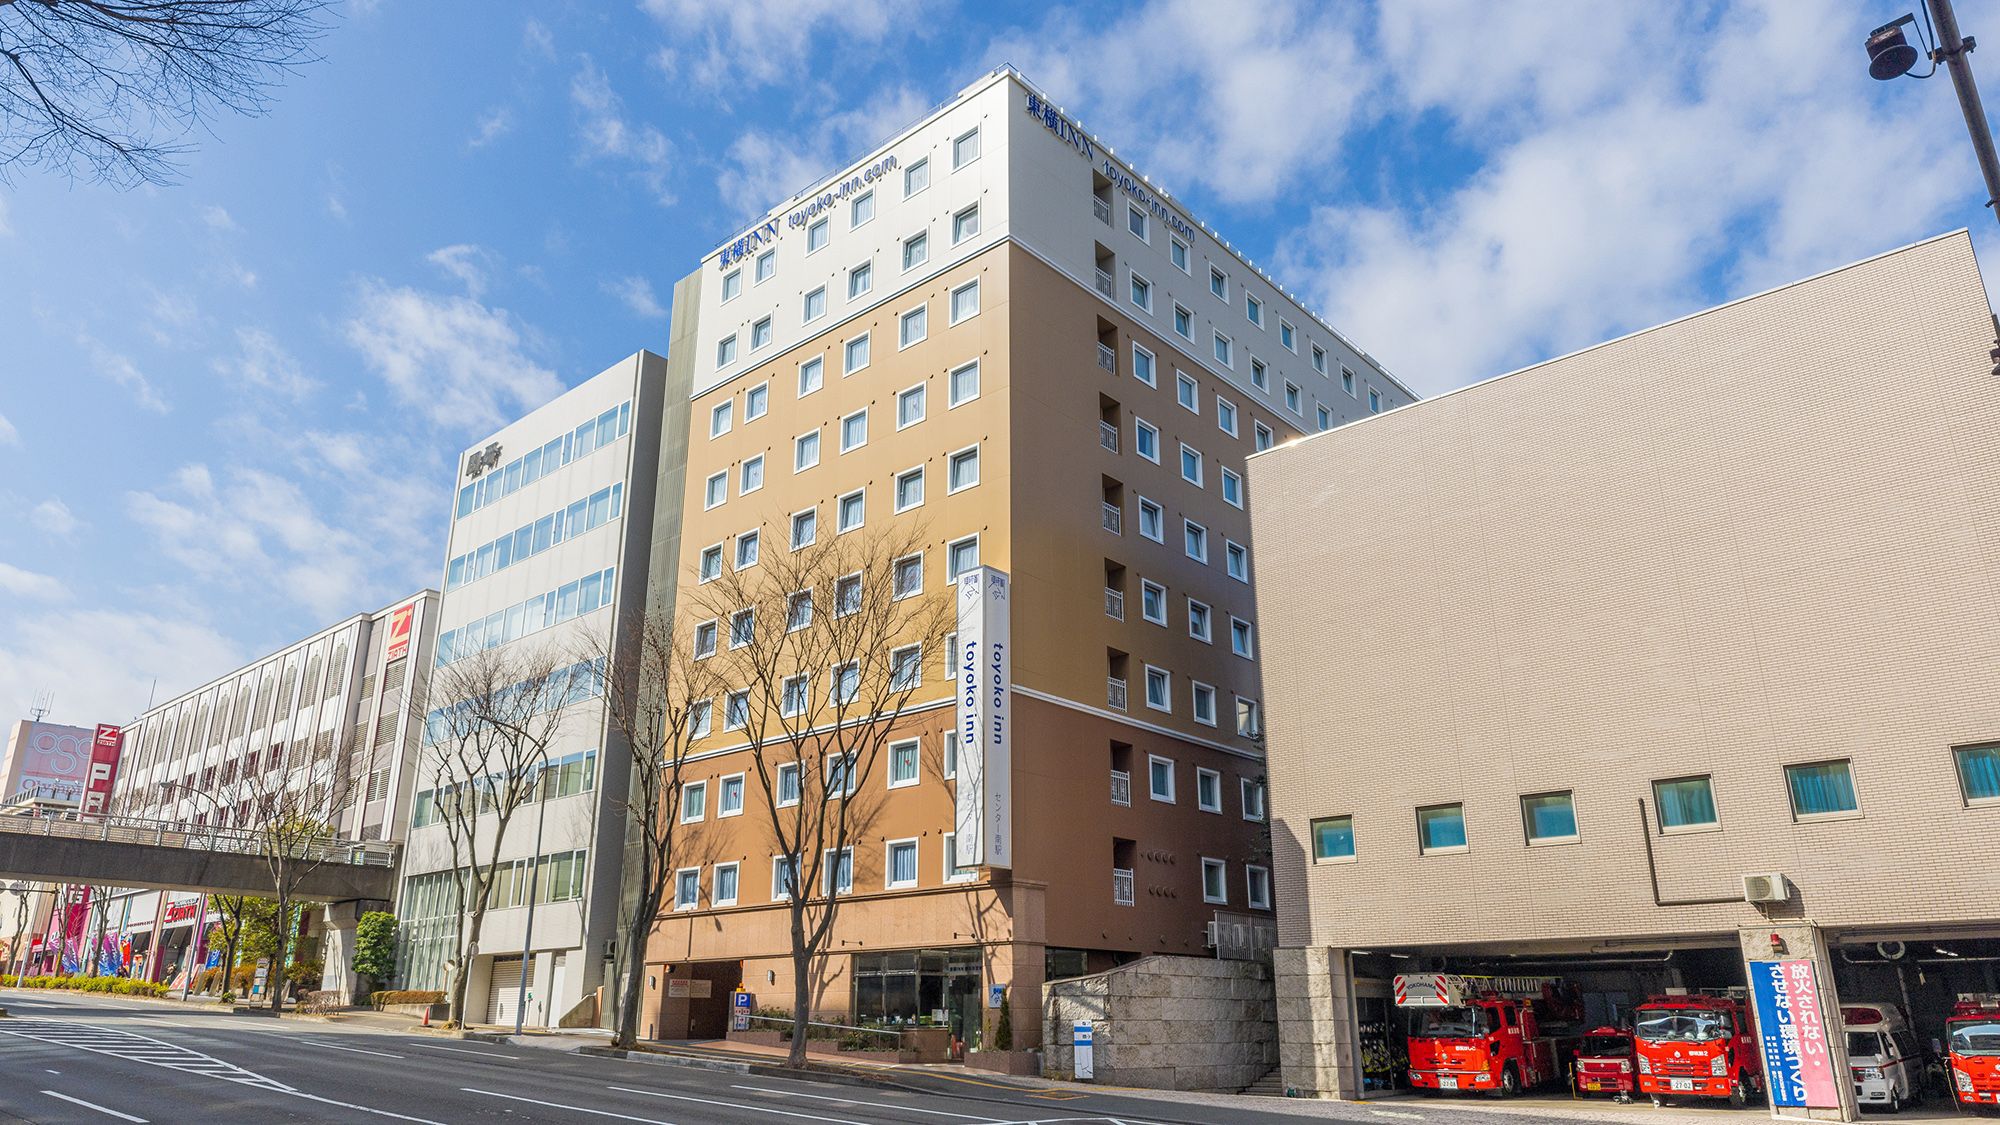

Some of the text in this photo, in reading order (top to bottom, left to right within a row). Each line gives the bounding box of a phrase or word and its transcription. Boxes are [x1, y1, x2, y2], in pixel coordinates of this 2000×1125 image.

[1027, 93, 1093, 161] 東横INN
[788, 155, 898, 229] toyoko-inn.com
[1103, 159, 1195, 242] toyoko-inn.com
[963, 641, 977, 744] toyoko inn
[991, 642, 1004, 745] toyoko inn
[737, 994, 748, 1006] P
